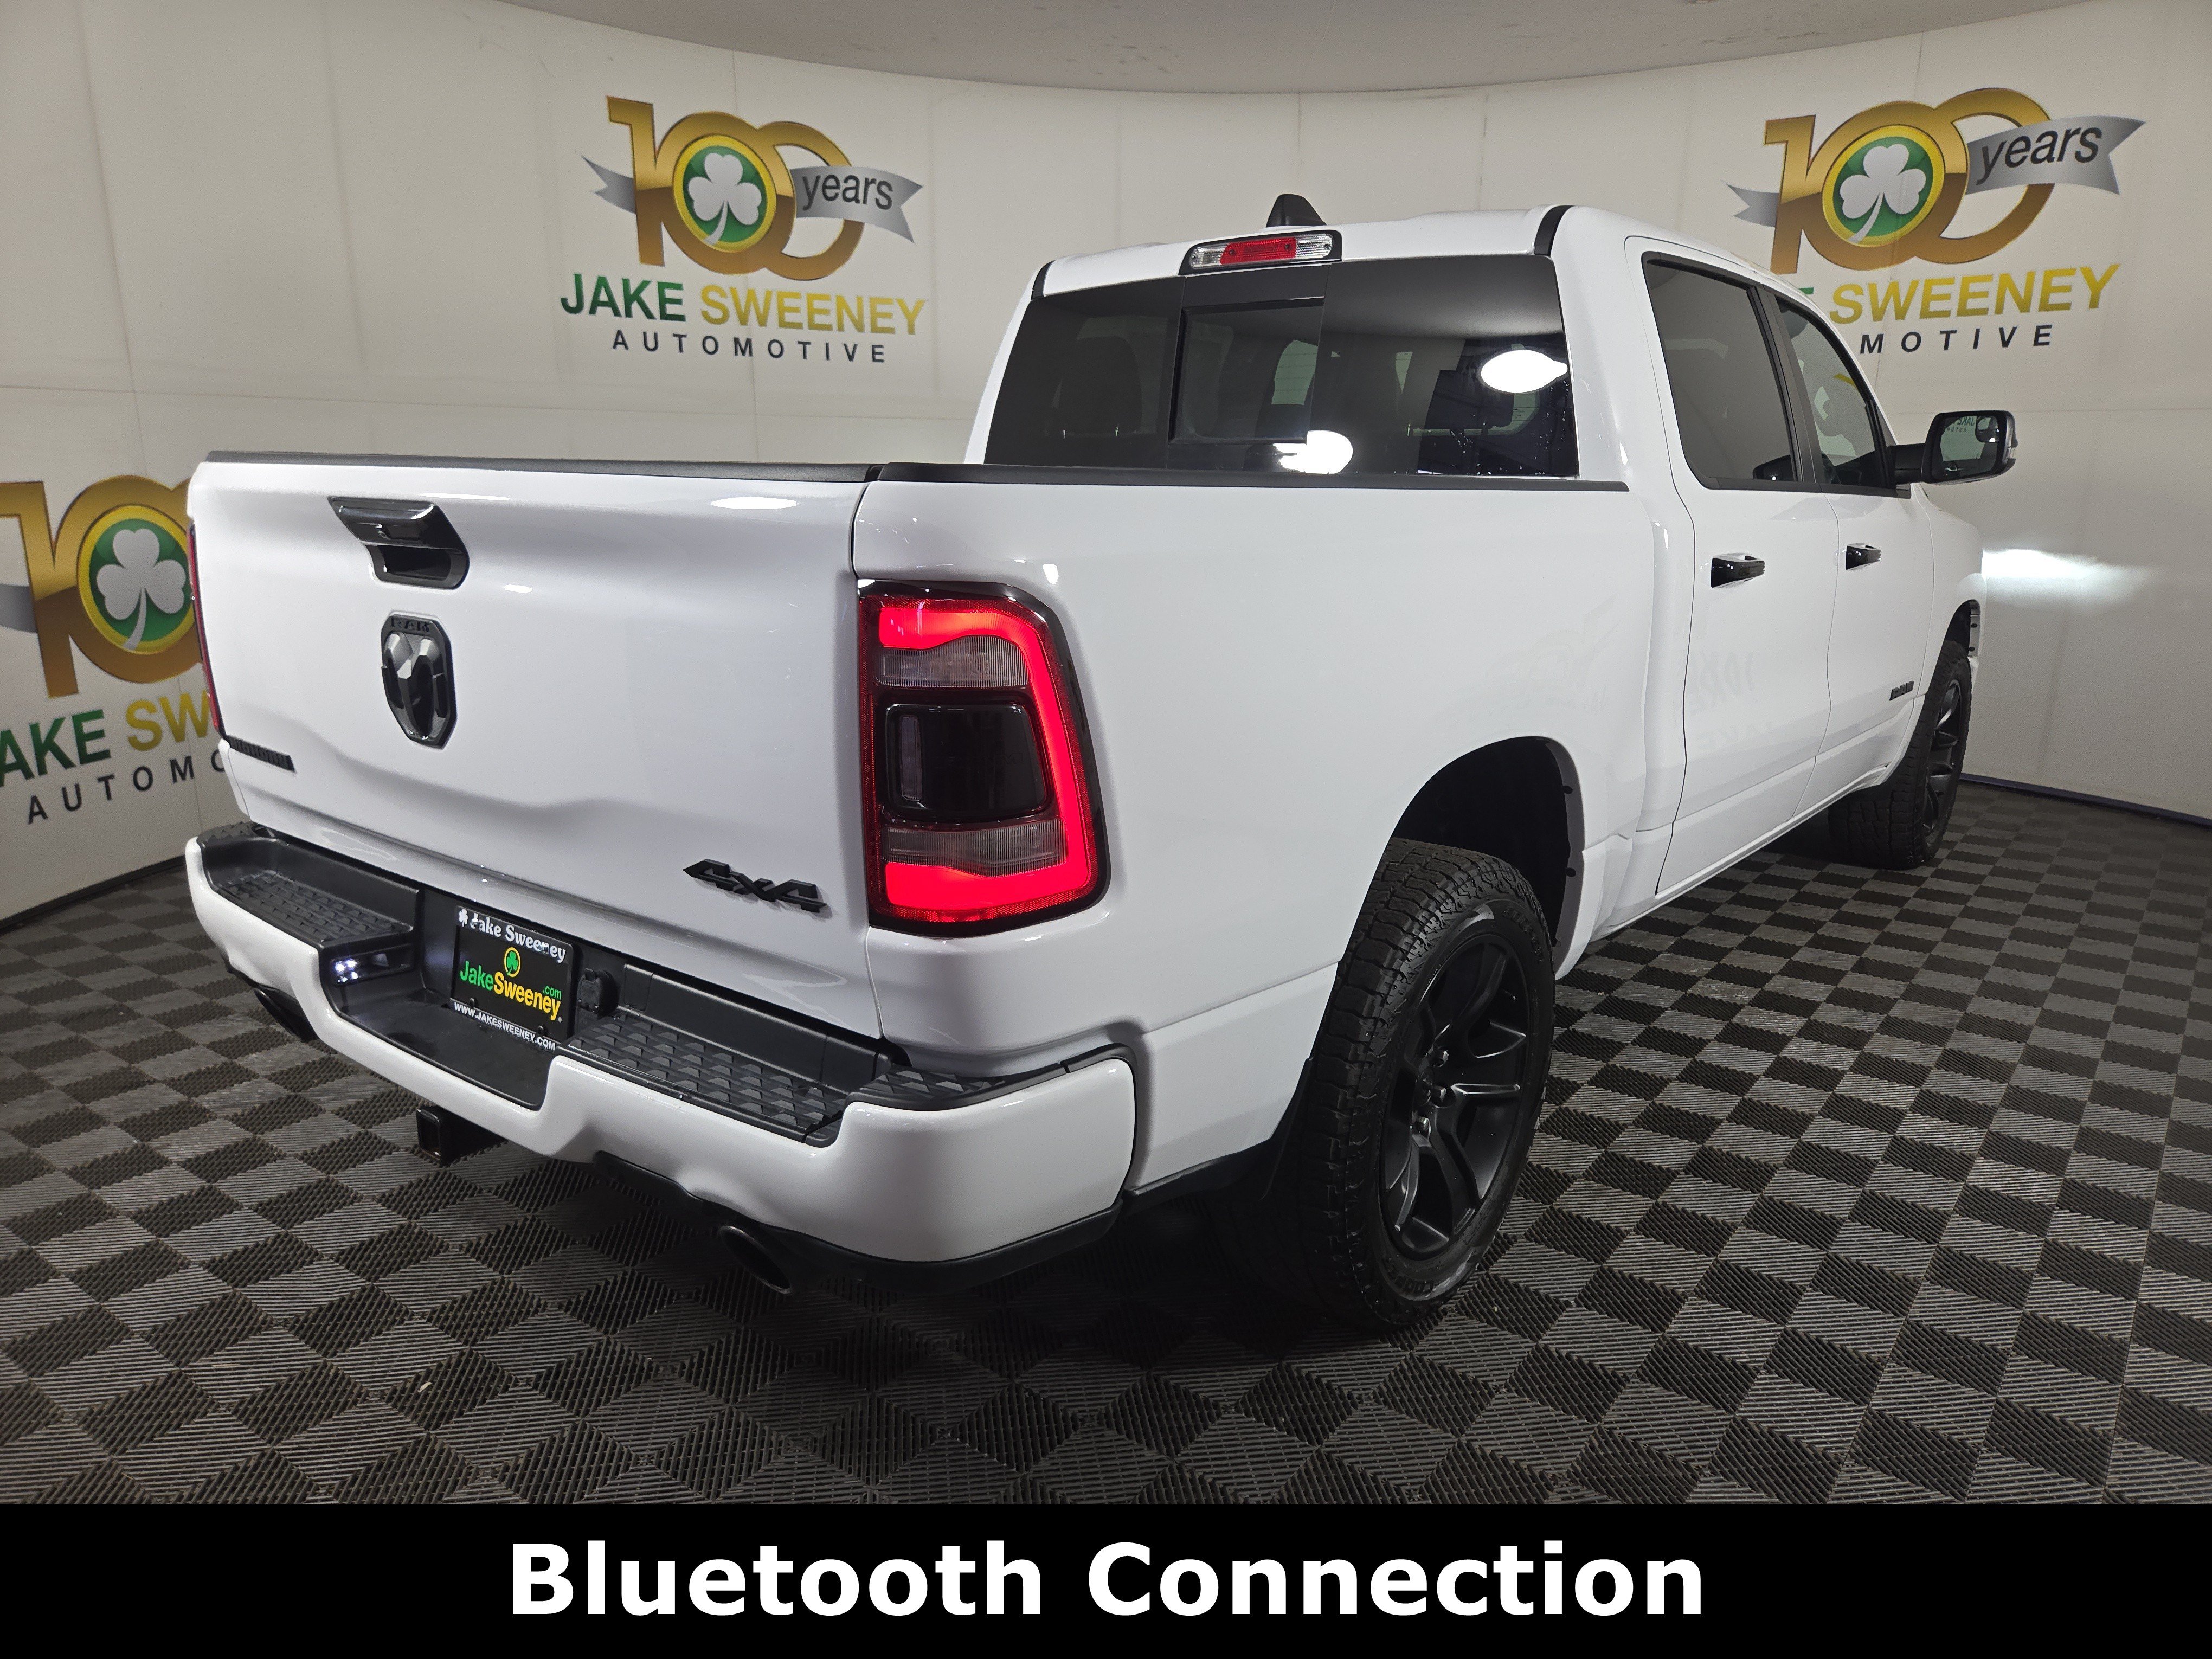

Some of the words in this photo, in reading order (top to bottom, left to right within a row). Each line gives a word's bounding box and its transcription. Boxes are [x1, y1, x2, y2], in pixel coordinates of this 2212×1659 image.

[1976, 127, 2101, 185] years
[802, 173, 893, 211] years
[561, 273, 686, 323] JAKE
[700, 285, 925, 336] SWEENEY
[1829, 264, 2120, 325] SWEENEY
[612, 330, 885, 363] AUTOMOTIVE
[1860, 324, 2054, 355] MOTIVE
[505, 924, 566, 964] Sweeney
[454, 1002, 556, 1051] WWW.JAKESWEENEY.COM
